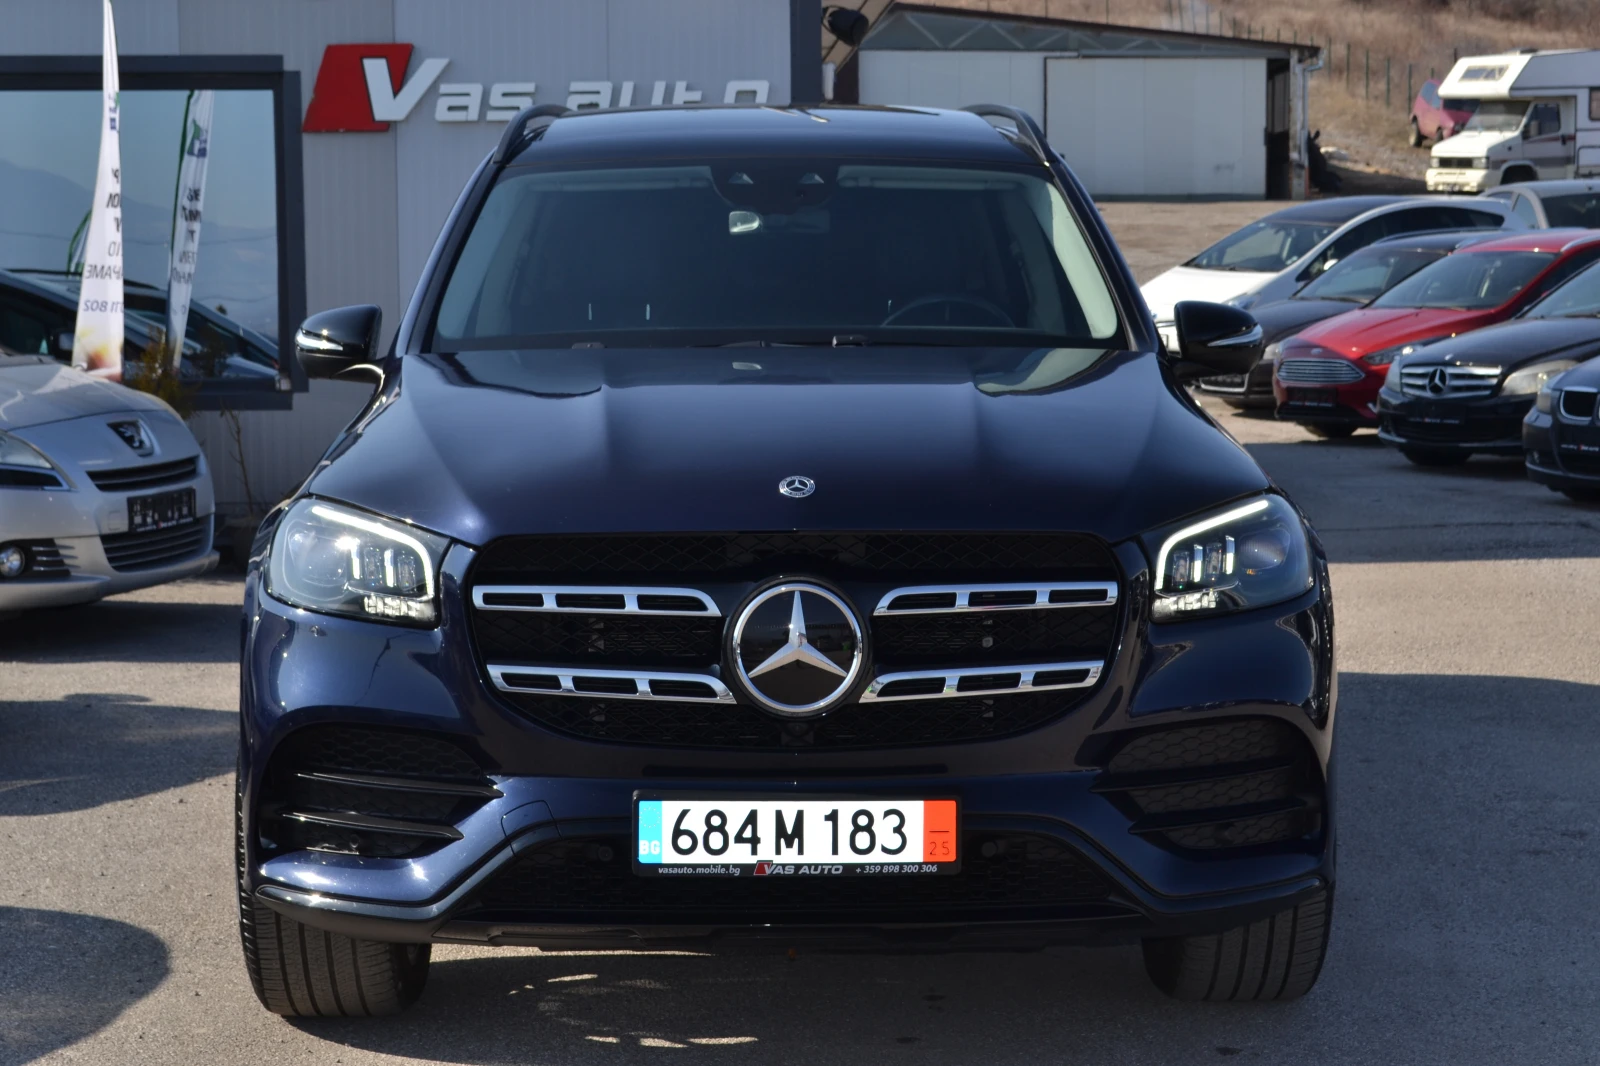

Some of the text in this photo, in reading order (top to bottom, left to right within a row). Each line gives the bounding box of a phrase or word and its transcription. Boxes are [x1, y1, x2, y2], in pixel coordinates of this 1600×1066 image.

[361, 57, 536, 122] Vas
[670, 808, 908, 856] 684 M 183
[638, 840, 661, 855] BG
[929, 840, 950, 856] 25
[657, 864, 741, 877] vasauto.mobile.bg
[763, 864, 843, 875] VAS AUTO
[882, 864, 900, 874] 898
[901, 864, 919, 873] 300
[920, 864, 938, 873] 306
